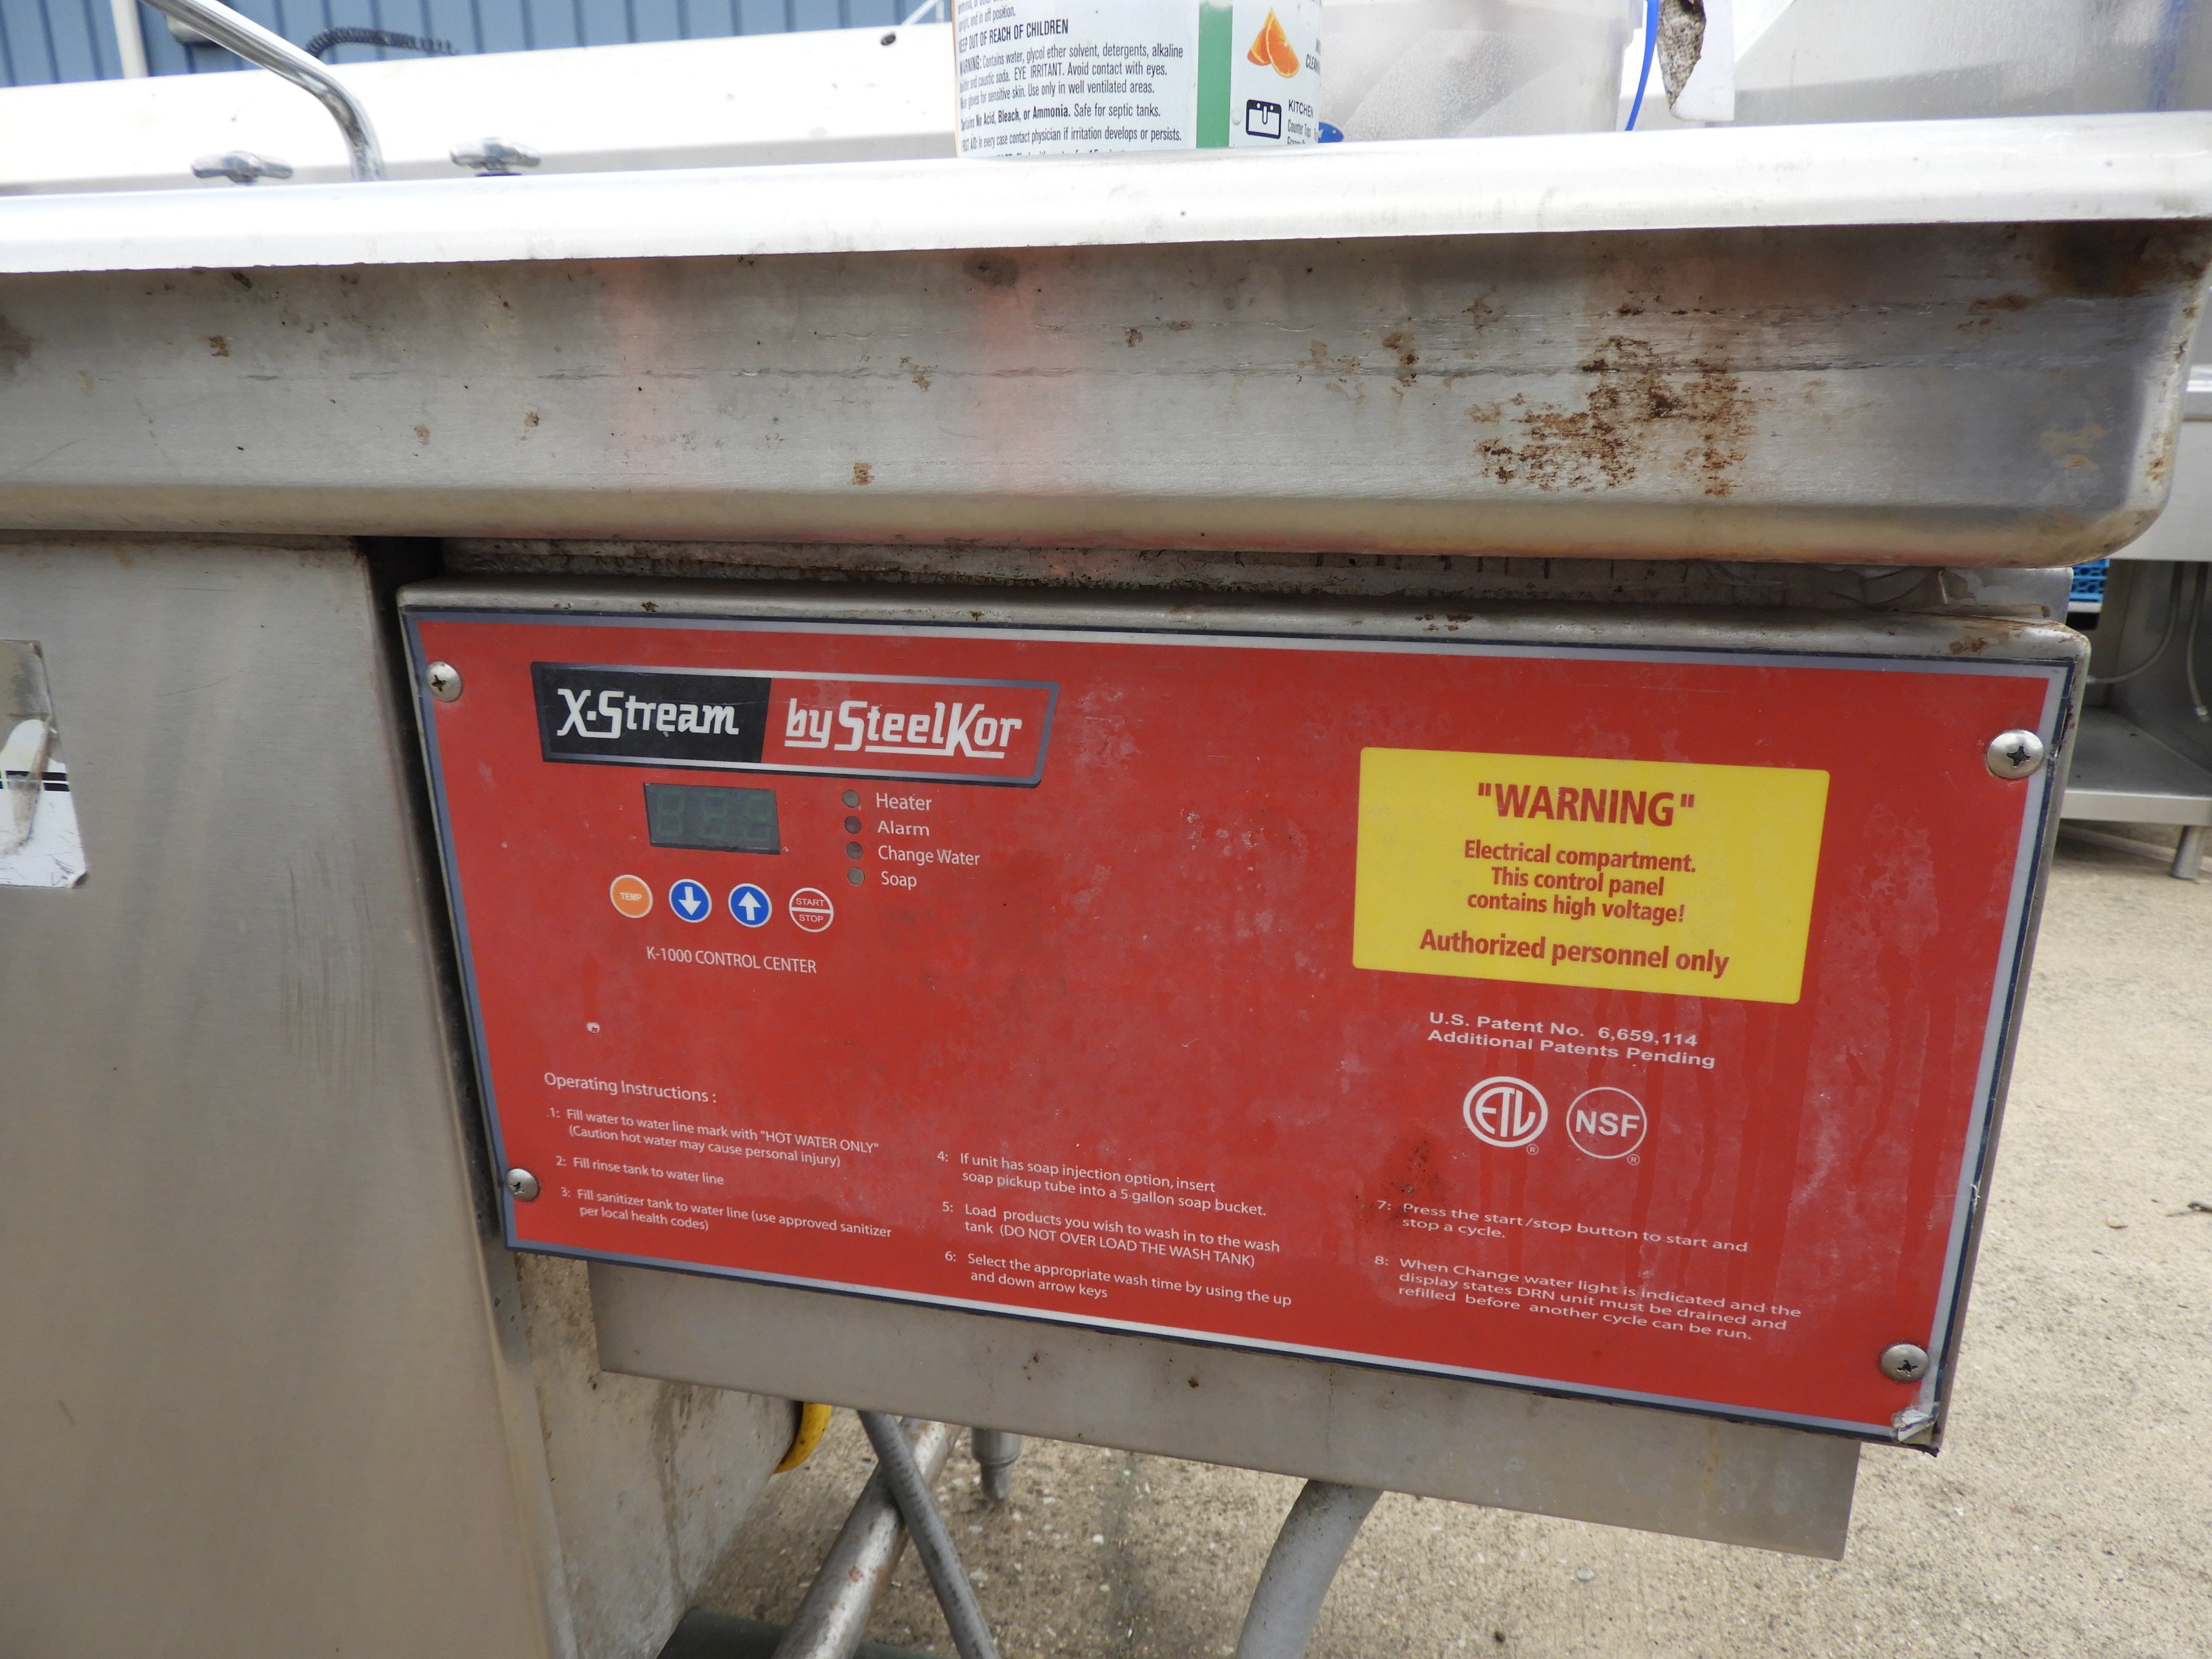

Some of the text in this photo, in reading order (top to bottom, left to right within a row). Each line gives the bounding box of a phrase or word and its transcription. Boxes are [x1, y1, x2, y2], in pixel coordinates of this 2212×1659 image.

[993, 7, 1016, 24] position.
[969, 34, 978, 49] OUT
[980, 31, 987, 46] OF
[989, 26, 1010, 44] REACH
[1014, 24, 1023, 39] OF
[1027, 19, 1068, 37] CHILDREN
[983, 52, 1004, 68] Contains
[1006, 51, 1024, 64] water,
[1027, 46, 1044, 64] glycol
[1047, 45, 1066, 58] ether
[1069, 43, 1099, 58] solvent,
[1103, 43, 1149, 59] detergents,
[1152, 43, 1183, 58] alkaline
[1015, 66, 1026, 80] EYE
[1031, 62, 1065, 78] IRRITANT.
[1067, 62, 1088, 75] Avoid
[1092, 62, 1122, 75] contact
[1125, 61, 1143, 75] with
[1147, 64, 1167, 77] eyes.
[983, 112, 996, 127] Acid,
[998, 107, 1021, 123] Bleach,
[1023, 110, 1030, 120] or
[1033, 104, 1071, 119] Ammonia.
[1074, 103, 1091, 117] Safe
[1094, 103, 1106, 117] for
[1109, 103, 1133, 119] septic
[1136, 103, 1160, 117] tanks.
[1288, 100, 1313, 118] KITCHEN
[997, 135, 1008, 146] case
[1010, 131, 1030, 144] contact
[1031, 127, 1061, 144] physician
[1063, 127, 1068, 140] if
[1071, 127, 1102, 140] irritation
[1105, 126, 1137, 142] develops
[1141, 129, 1148, 140] or
[1151, 127, 1181, 142] persists.
[784, 698, 832, 749] by
[834, 699, 1022, 760] SteelKor
[876, 792, 932, 811] Heater
[1478, 783, 1694, 827] "WARNING"
[878, 821, 929, 836] Alarm
[878, 845, 980, 865] Change Water
[1465, 840, 1696, 872] Electrical compartment.
[881, 871, 917, 890] Soap
[1492, 867, 1664, 898] This control panel
[619, 891, 642, 902] TEMP
[795, 897, 825, 908] START
[1468, 893, 1684, 926] contains high voltage!
[798, 913, 824, 924] STOP
[647, 946, 817, 973] K-1000 CONTROL CENTER
[1420, 929, 1729, 979] Authorized personnel only
[1430, 1012, 1697, 1046] U.S. Patent No. 6,659,114
[1427, 1029, 1715, 1069] Additional Patents Pending
[544, 1072, 708, 1102] Operating Instructions
[550, 1107, 878, 1153] 1: Fill water to water line mark with "HOT WATER ONLY"
[1574, 1109, 1641, 1139] NSF
[569, 1125, 840, 1168] (Caution hot water may cause personal injury)
[937, 1151, 1215, 1192] 4: If unit has soap injection option, insert
[561, 1187, 891, 1237] 3: Fill sanitizer tank to water line (use approved sanitizer
[1378, 1200, 1391, 1210] 7:
[1404, 1203, 1446, 1216] Press
[1450, 1209, 1479, 1221] the
[1577, 1223, 1637, 1239] button
[1643, 1232, 1661, 1242] to
[1666, 1235, 1708, 1247] start
[1713, 1242, 1748, 1252] and
[1402, 1219, 1439, 1231] stop
[1458, 1226, 1505, 1238] cycle.
[965, 1221, 1254, 1268] tank (DO NOT OVER LOAD THE WASH TANK)
[1374, 1256, 1801, 1317] 8: When Change water light is indicated and the
[1399, 1288, 1751, 1340] refilled before another cycle can be run.
